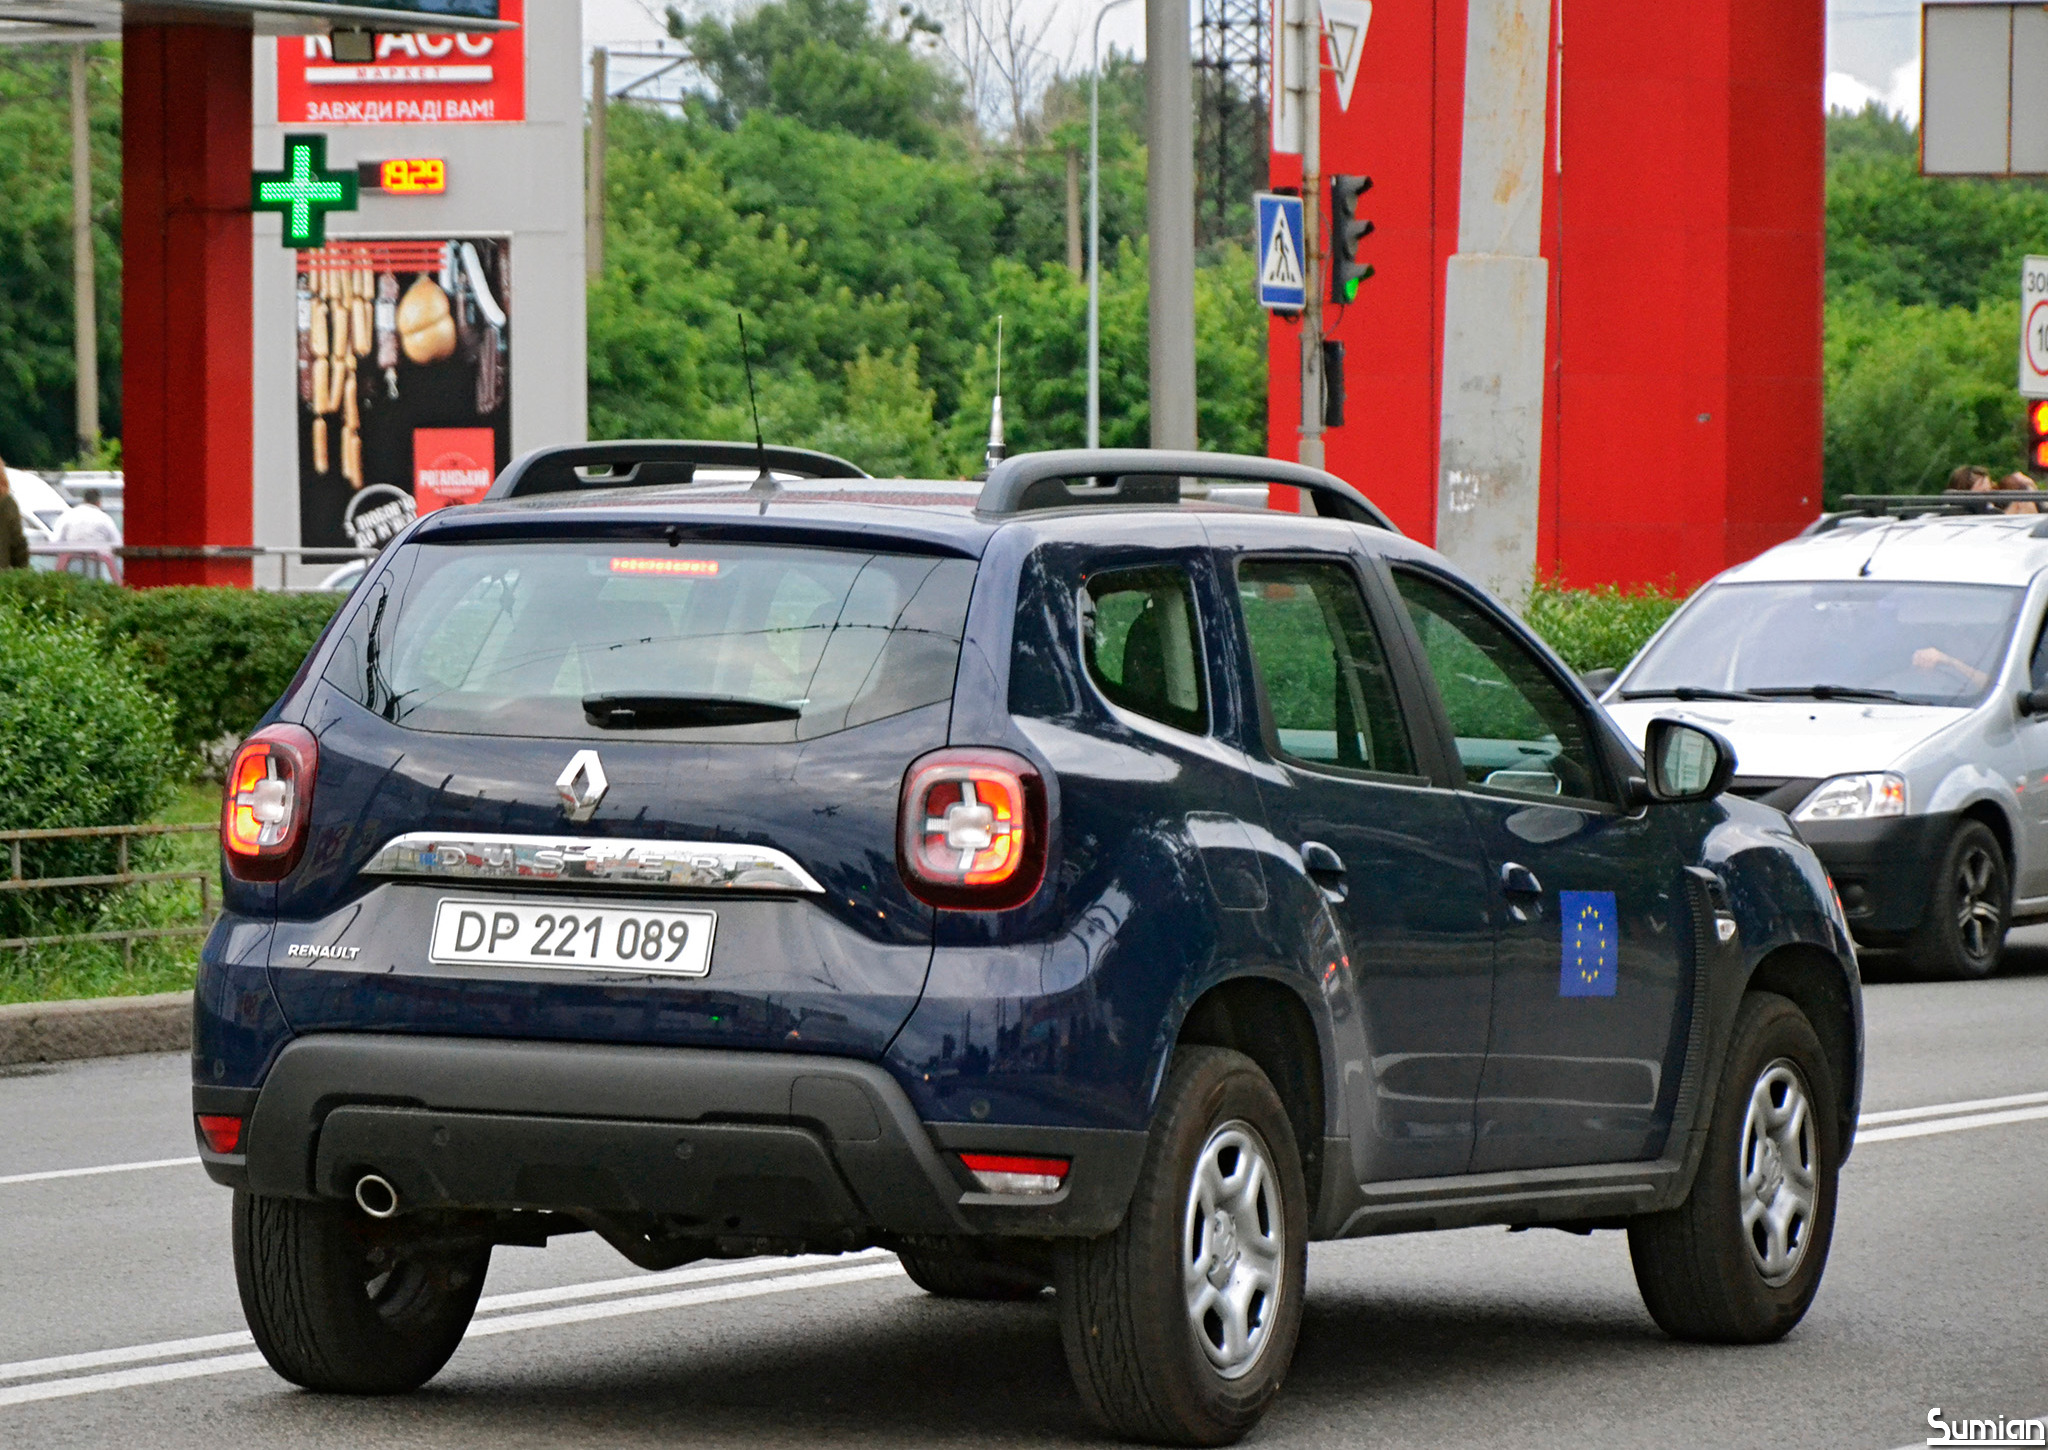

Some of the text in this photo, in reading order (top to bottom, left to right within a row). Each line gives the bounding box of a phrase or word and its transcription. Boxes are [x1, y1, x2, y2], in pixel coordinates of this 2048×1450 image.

[304, 33, 494, 58] КАСС
[356, 66, 442, 79] МАРКЕТ
[306, 99, 495, 122] ЗАВЖДИ РАДІ ВАМ!
[437, 846, 721, 878] DUSTER
[455, 910, 690, 963] DP 221 089
[287, 944, 361, 960] RENAULT
